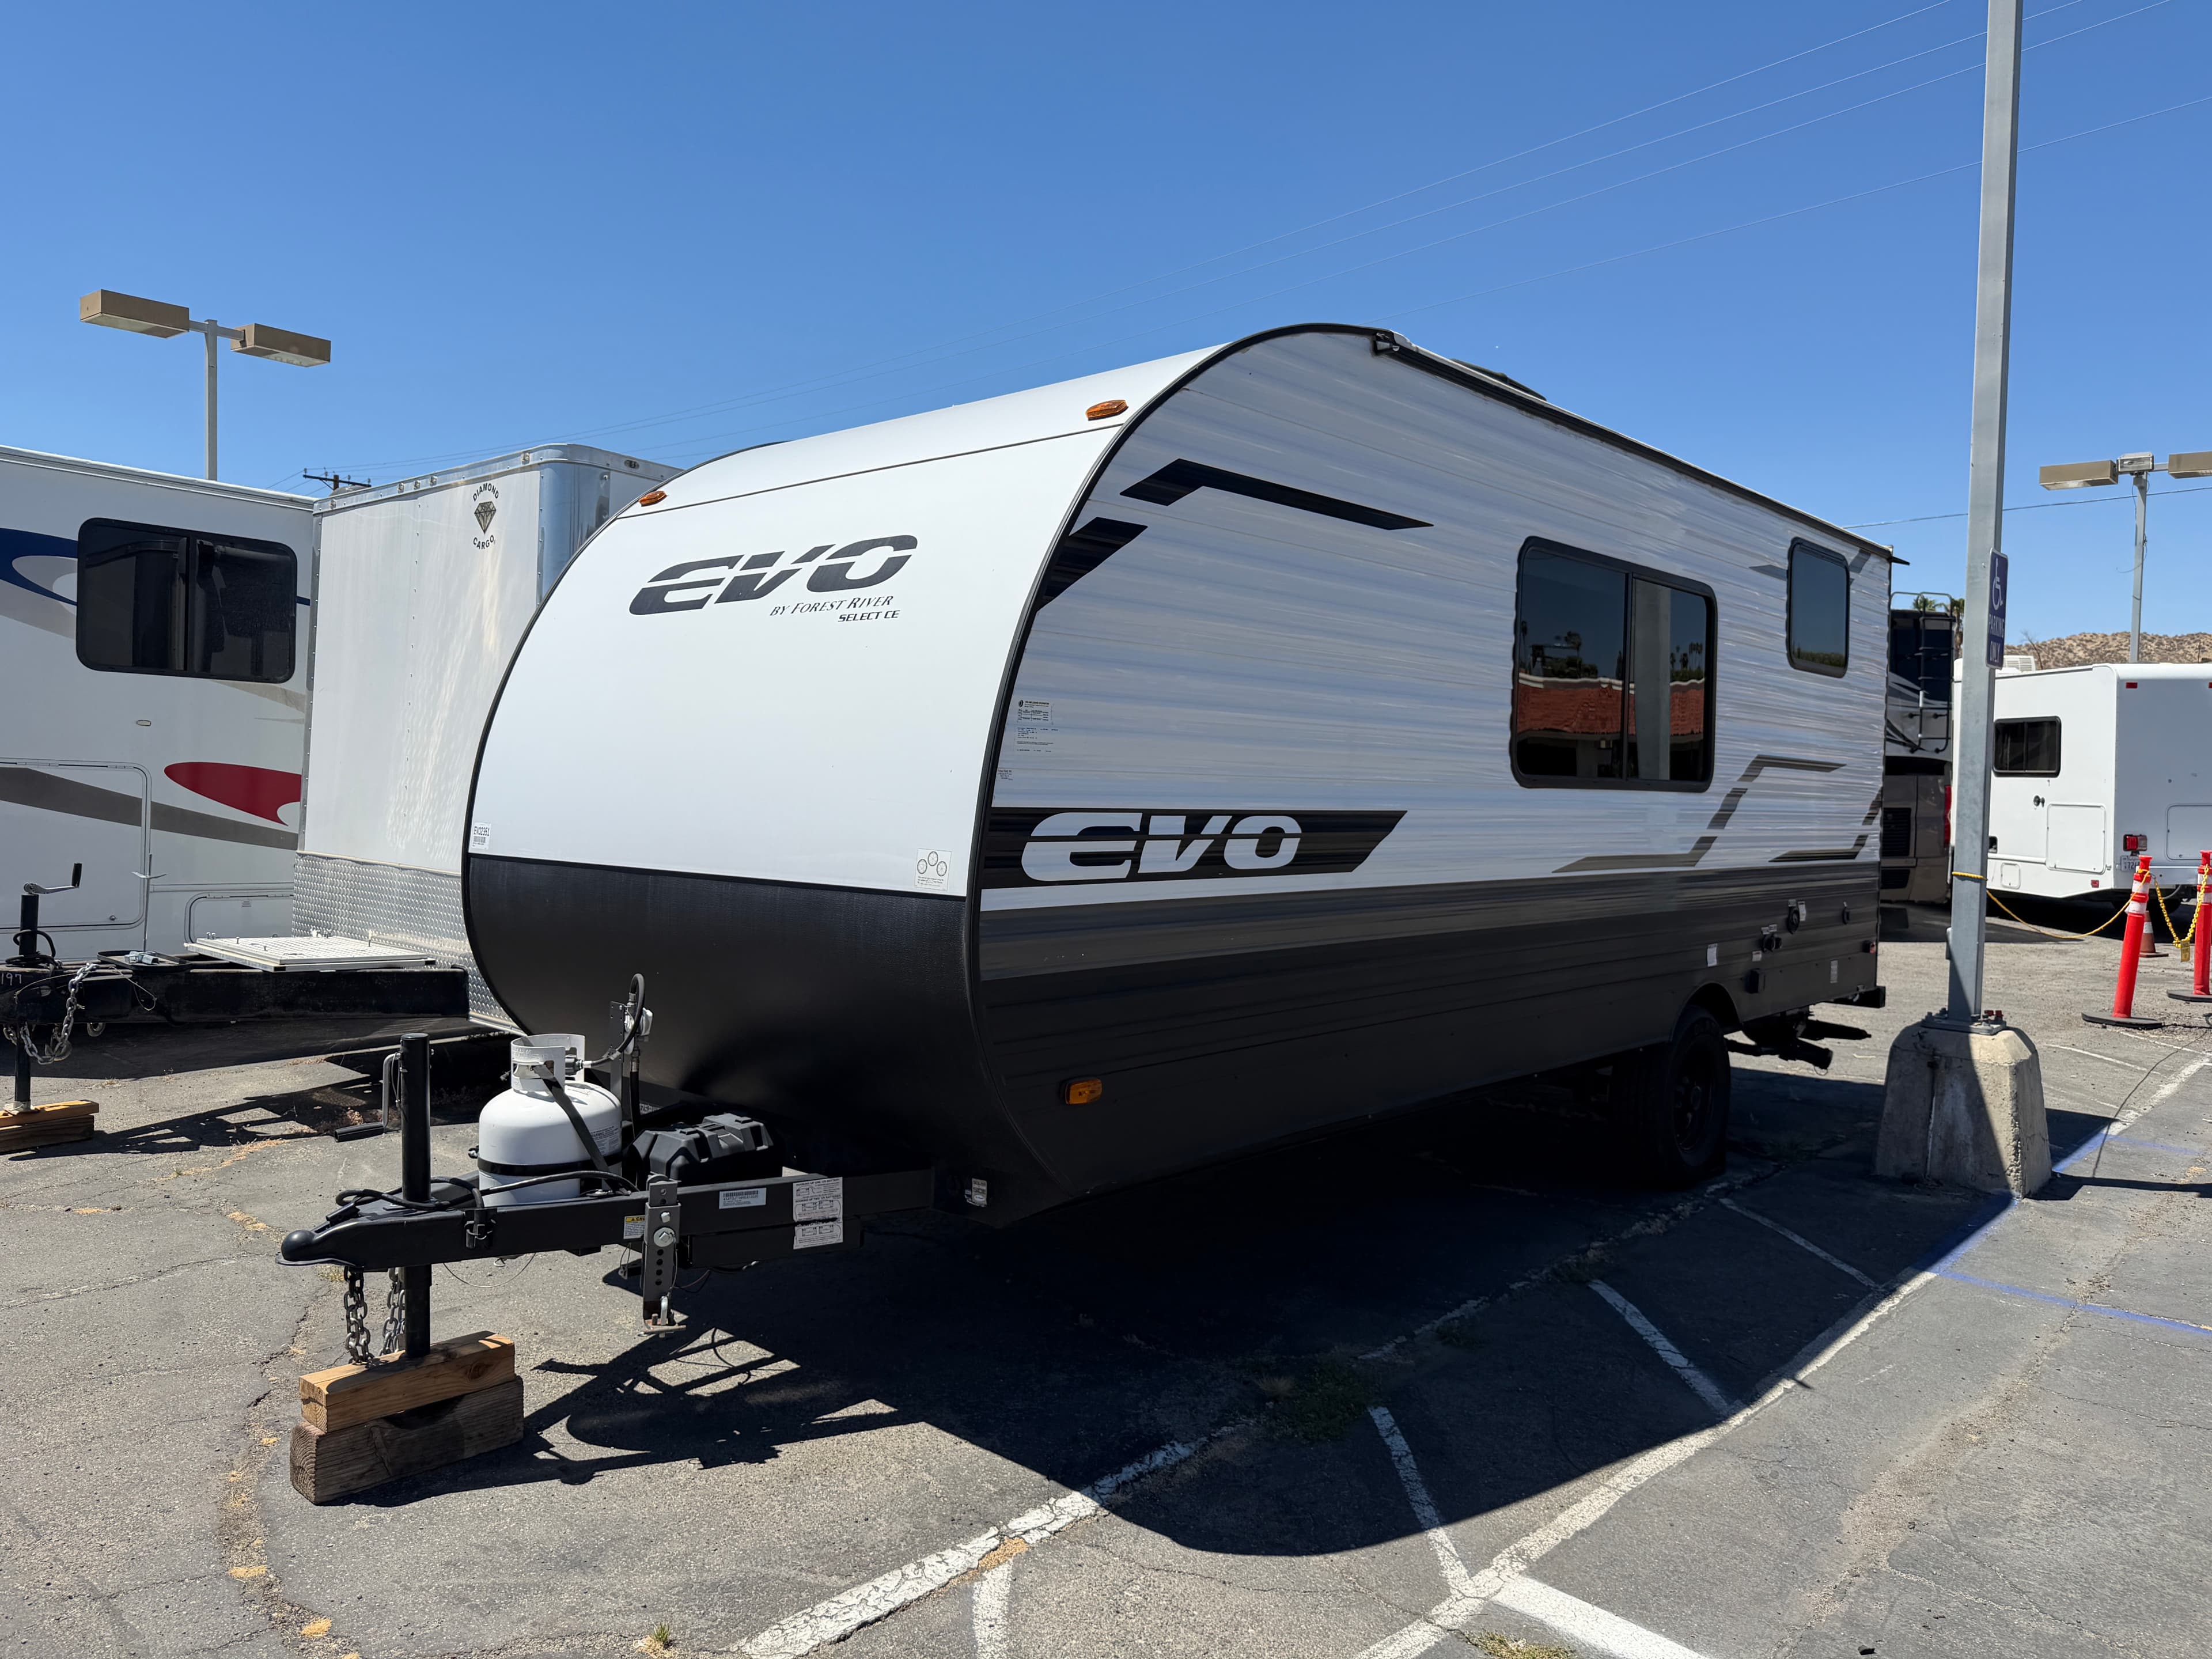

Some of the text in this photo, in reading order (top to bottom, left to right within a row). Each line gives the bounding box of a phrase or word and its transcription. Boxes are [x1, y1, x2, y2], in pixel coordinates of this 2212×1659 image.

[473, 483, 499, 501] DIAMOND
[473, 535, 494, 549] CARGO
[629, 535, 918, 616] EVO
[770, 596, 893, 616] BY FOREST RIVER
[838, 609, 900, 623] SELECT CE
[1988, 613, 2005, 638] PARKING
[1990, 641, 2001, 663] ONLY
[1021, 812, 1302, 881] EVO
